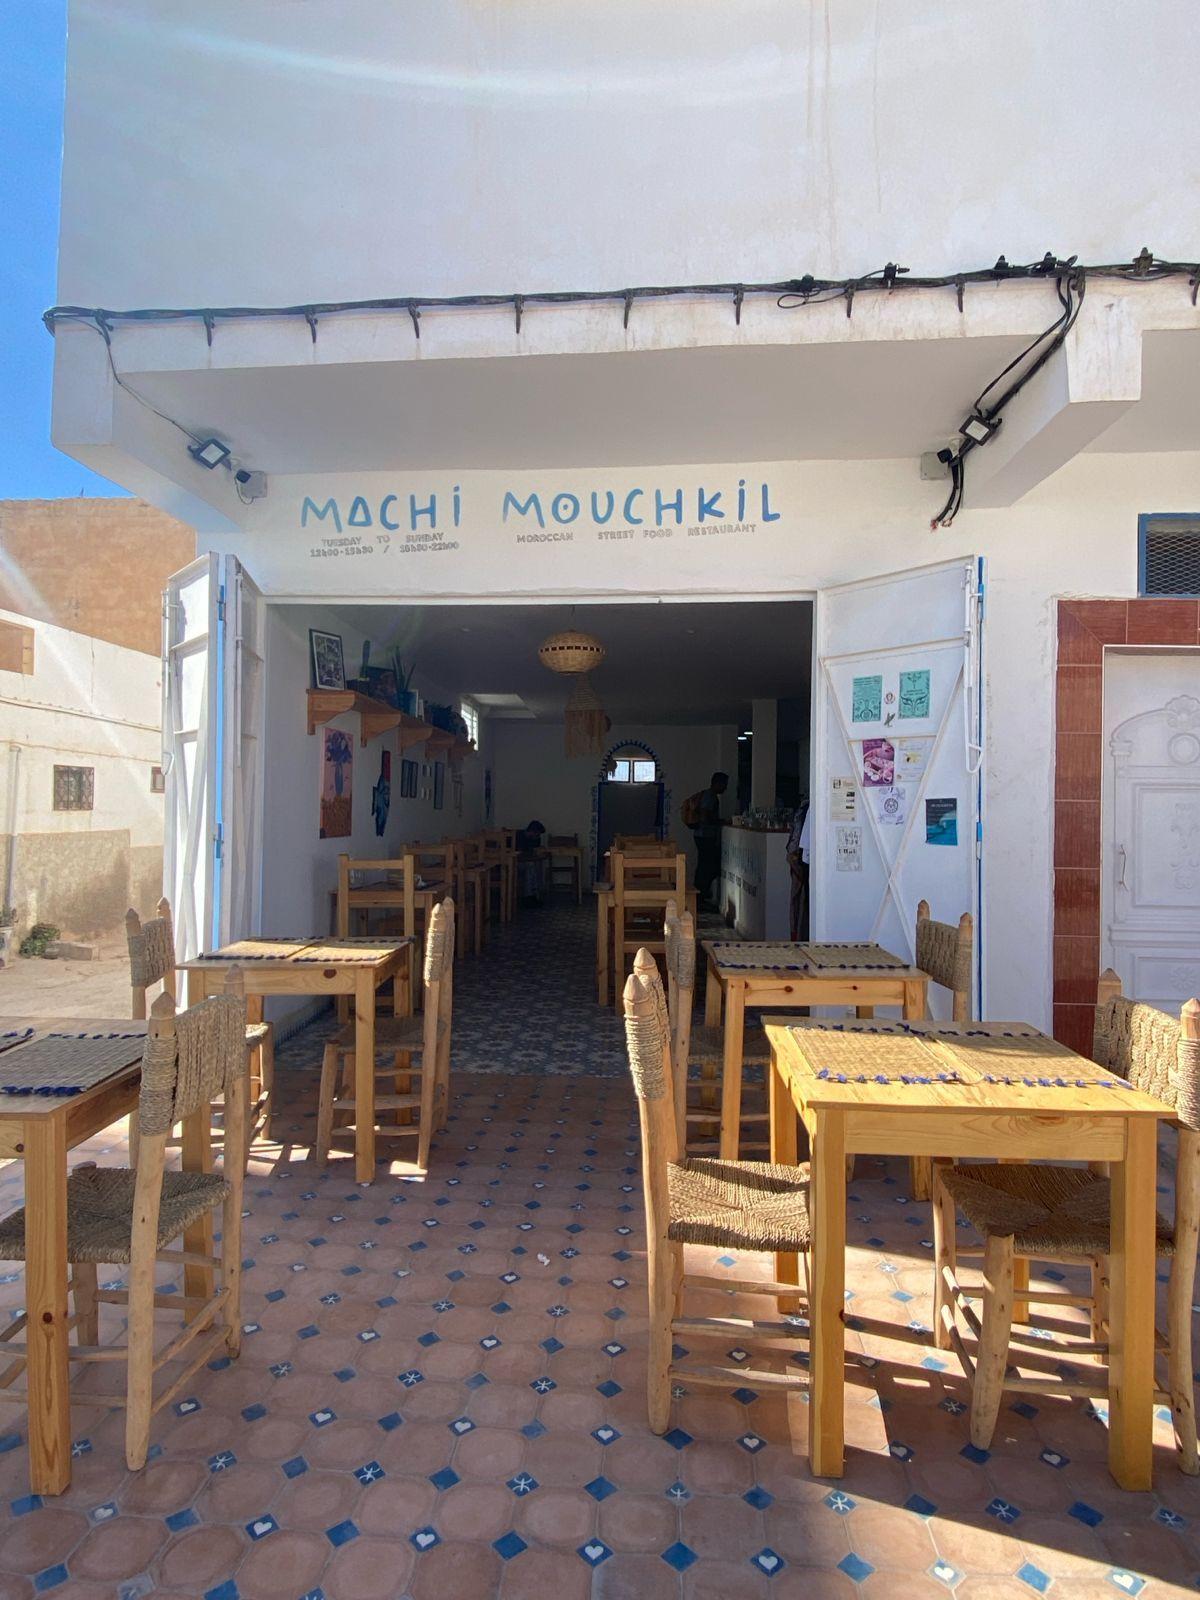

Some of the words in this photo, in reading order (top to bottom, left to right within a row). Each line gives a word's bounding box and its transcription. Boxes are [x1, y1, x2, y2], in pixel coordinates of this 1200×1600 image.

[321, 535, 362, 547] TUESDAY
[376, 534, 391, 544] TO
[405, 532, 444, 544] SUNDAY
[516, 531, 574, 544] MOROCCAN
[597, 529, 635, 541] STREET
[643, 527, 673, 539] FOOD
[687, 523, 757, 537] RESTAURANT
